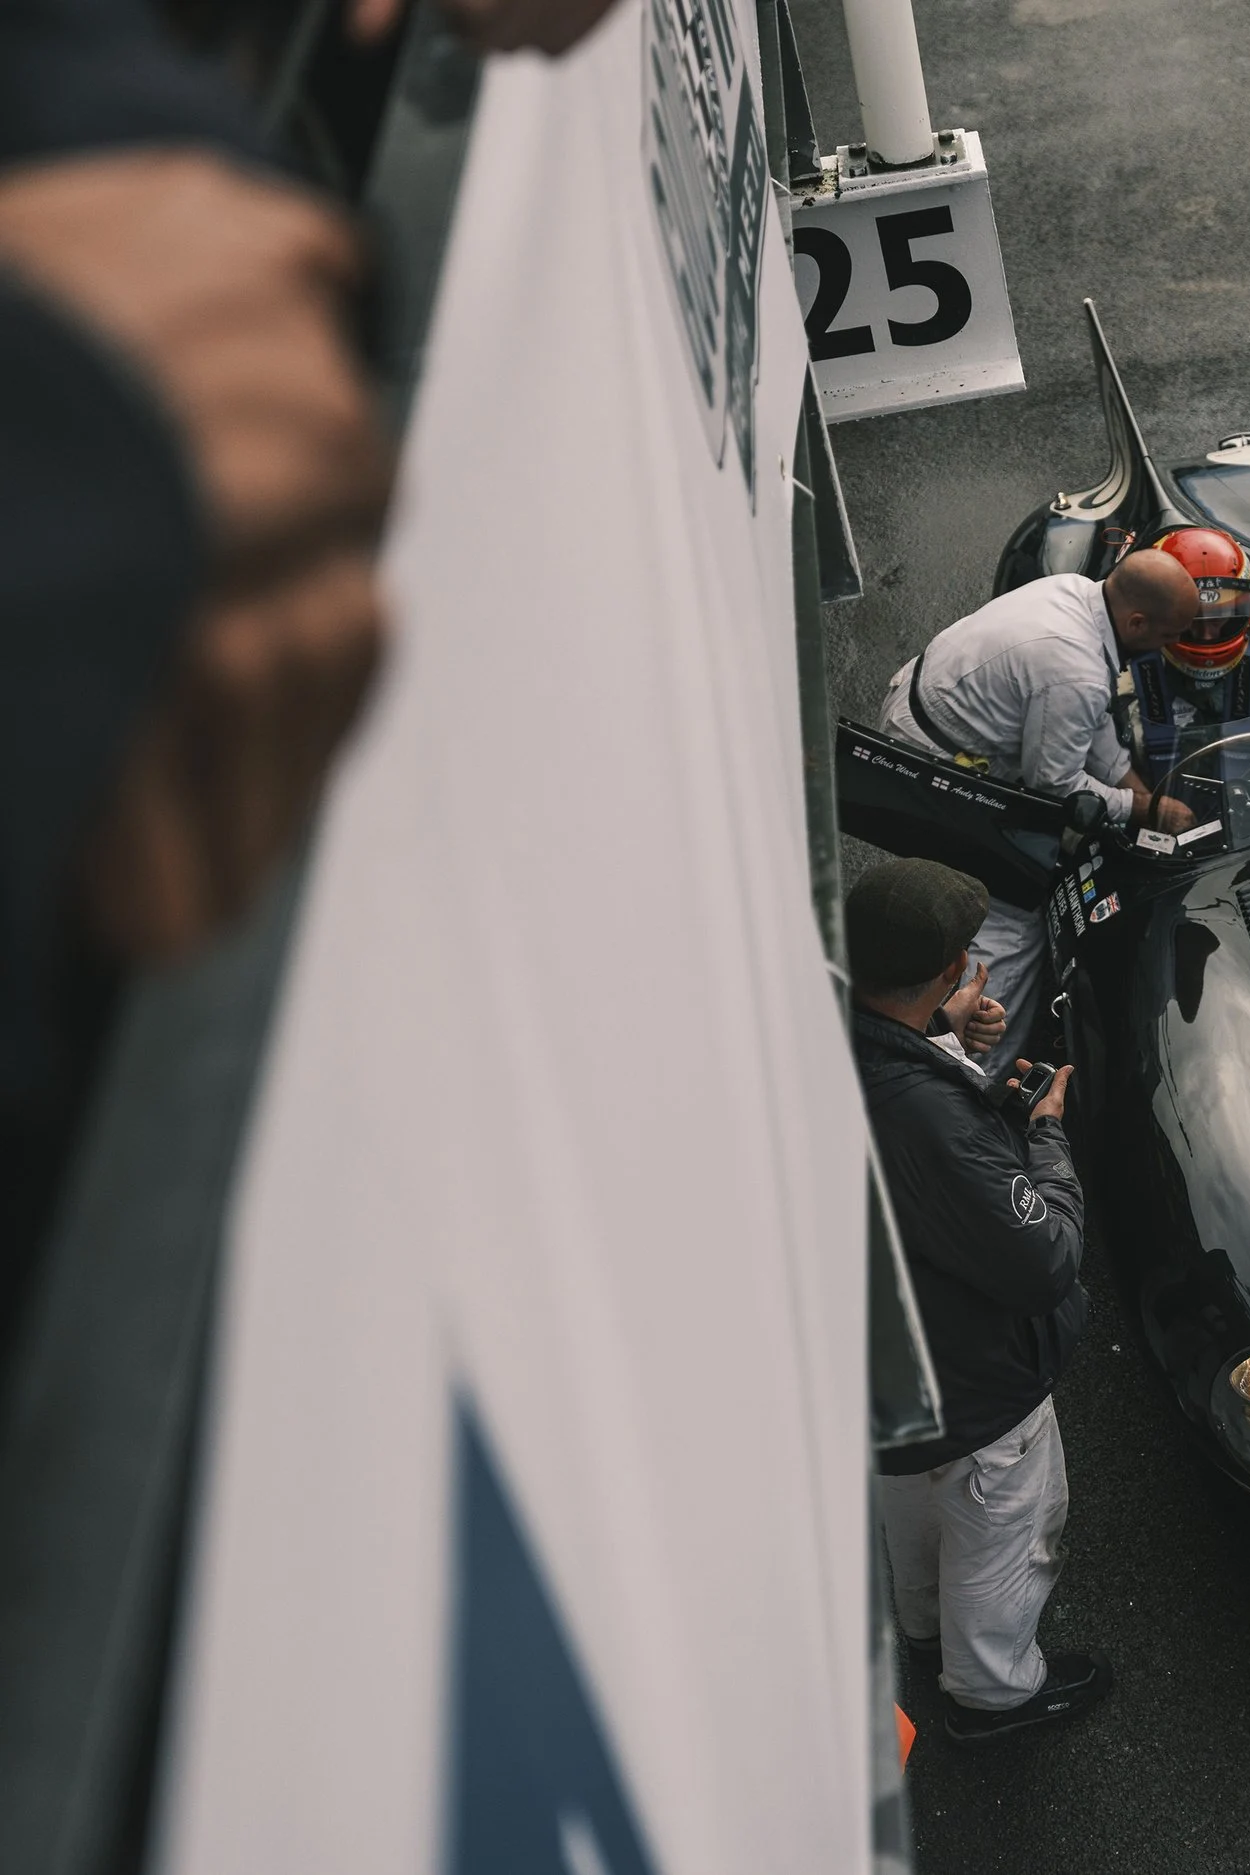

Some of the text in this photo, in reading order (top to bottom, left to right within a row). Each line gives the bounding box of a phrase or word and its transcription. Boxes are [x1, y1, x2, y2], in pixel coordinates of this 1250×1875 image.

[794, 205, 972, 362] 25
[871, 755, 920, 779] Chris Ward
[950, 786, 1007, 810] Andy Wallace
